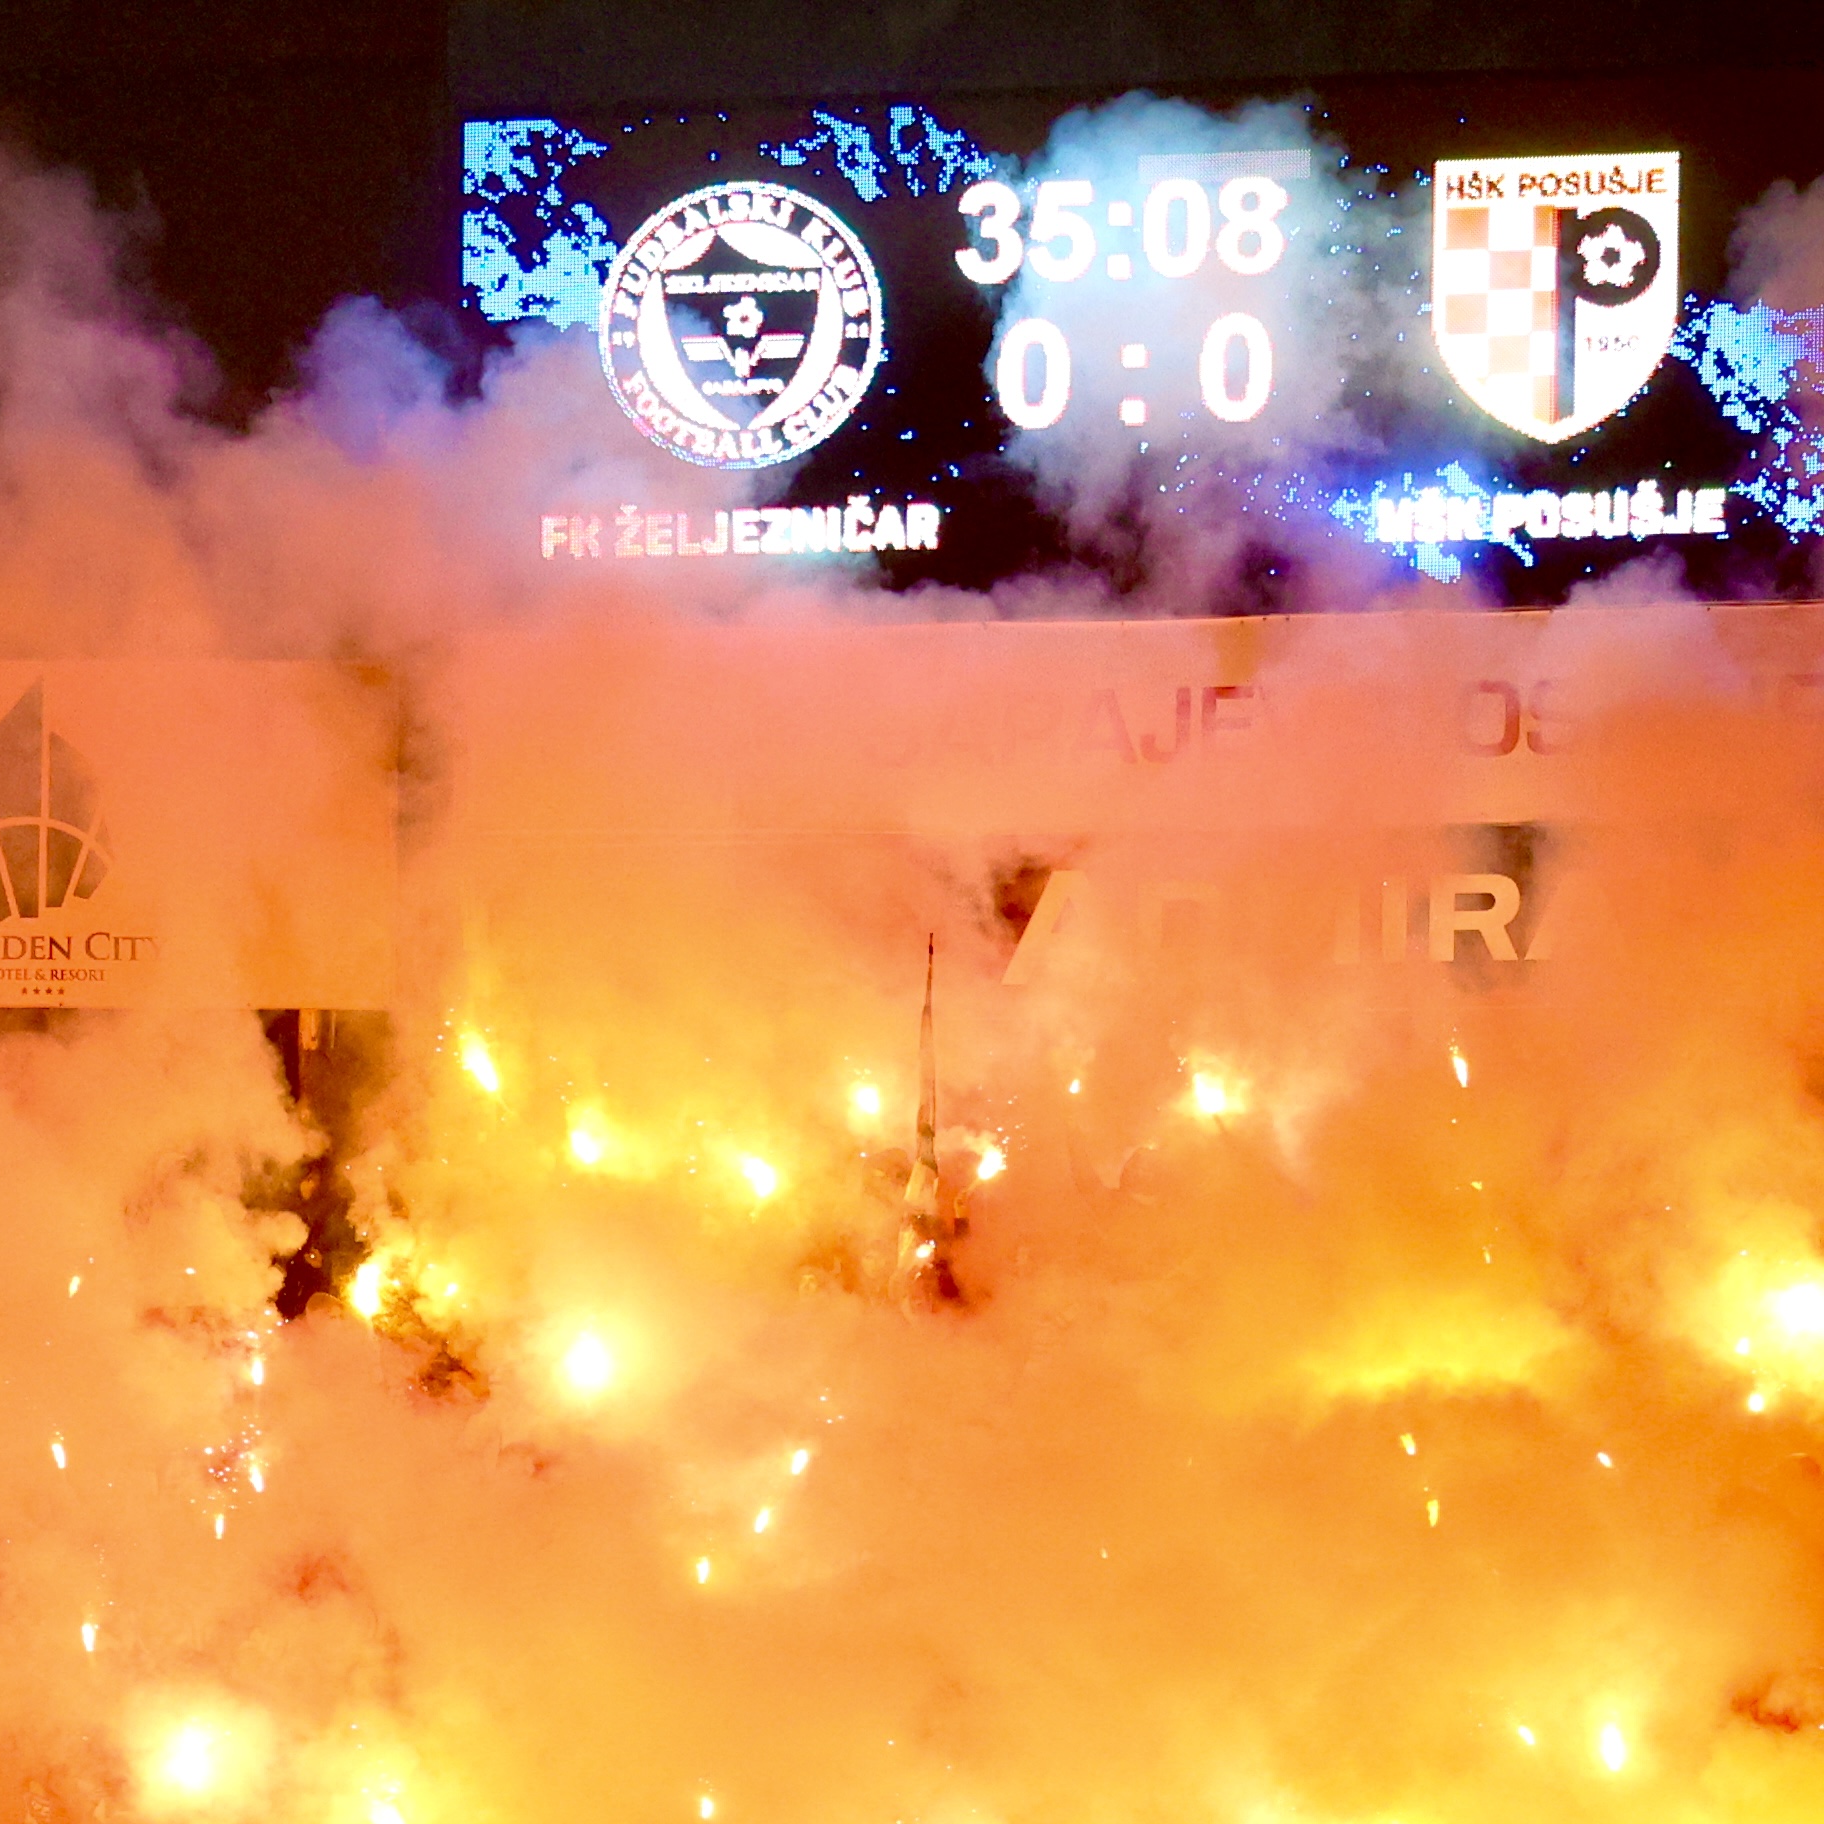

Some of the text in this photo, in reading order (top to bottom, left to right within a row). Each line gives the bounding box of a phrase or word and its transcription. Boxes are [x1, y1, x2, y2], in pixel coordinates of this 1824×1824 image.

[1446, 165, 1669, 201] HŠK POSUŠJE
[954, 178, 1289, 285] 35:08
[999, 319, 1071, 429] 0
[1200, 312, 1273, 423] 0
[540, 495, 943, 560] FK ŽELJEZNIČAR
[1492, 479, 1727, 540] POSUŠJE
